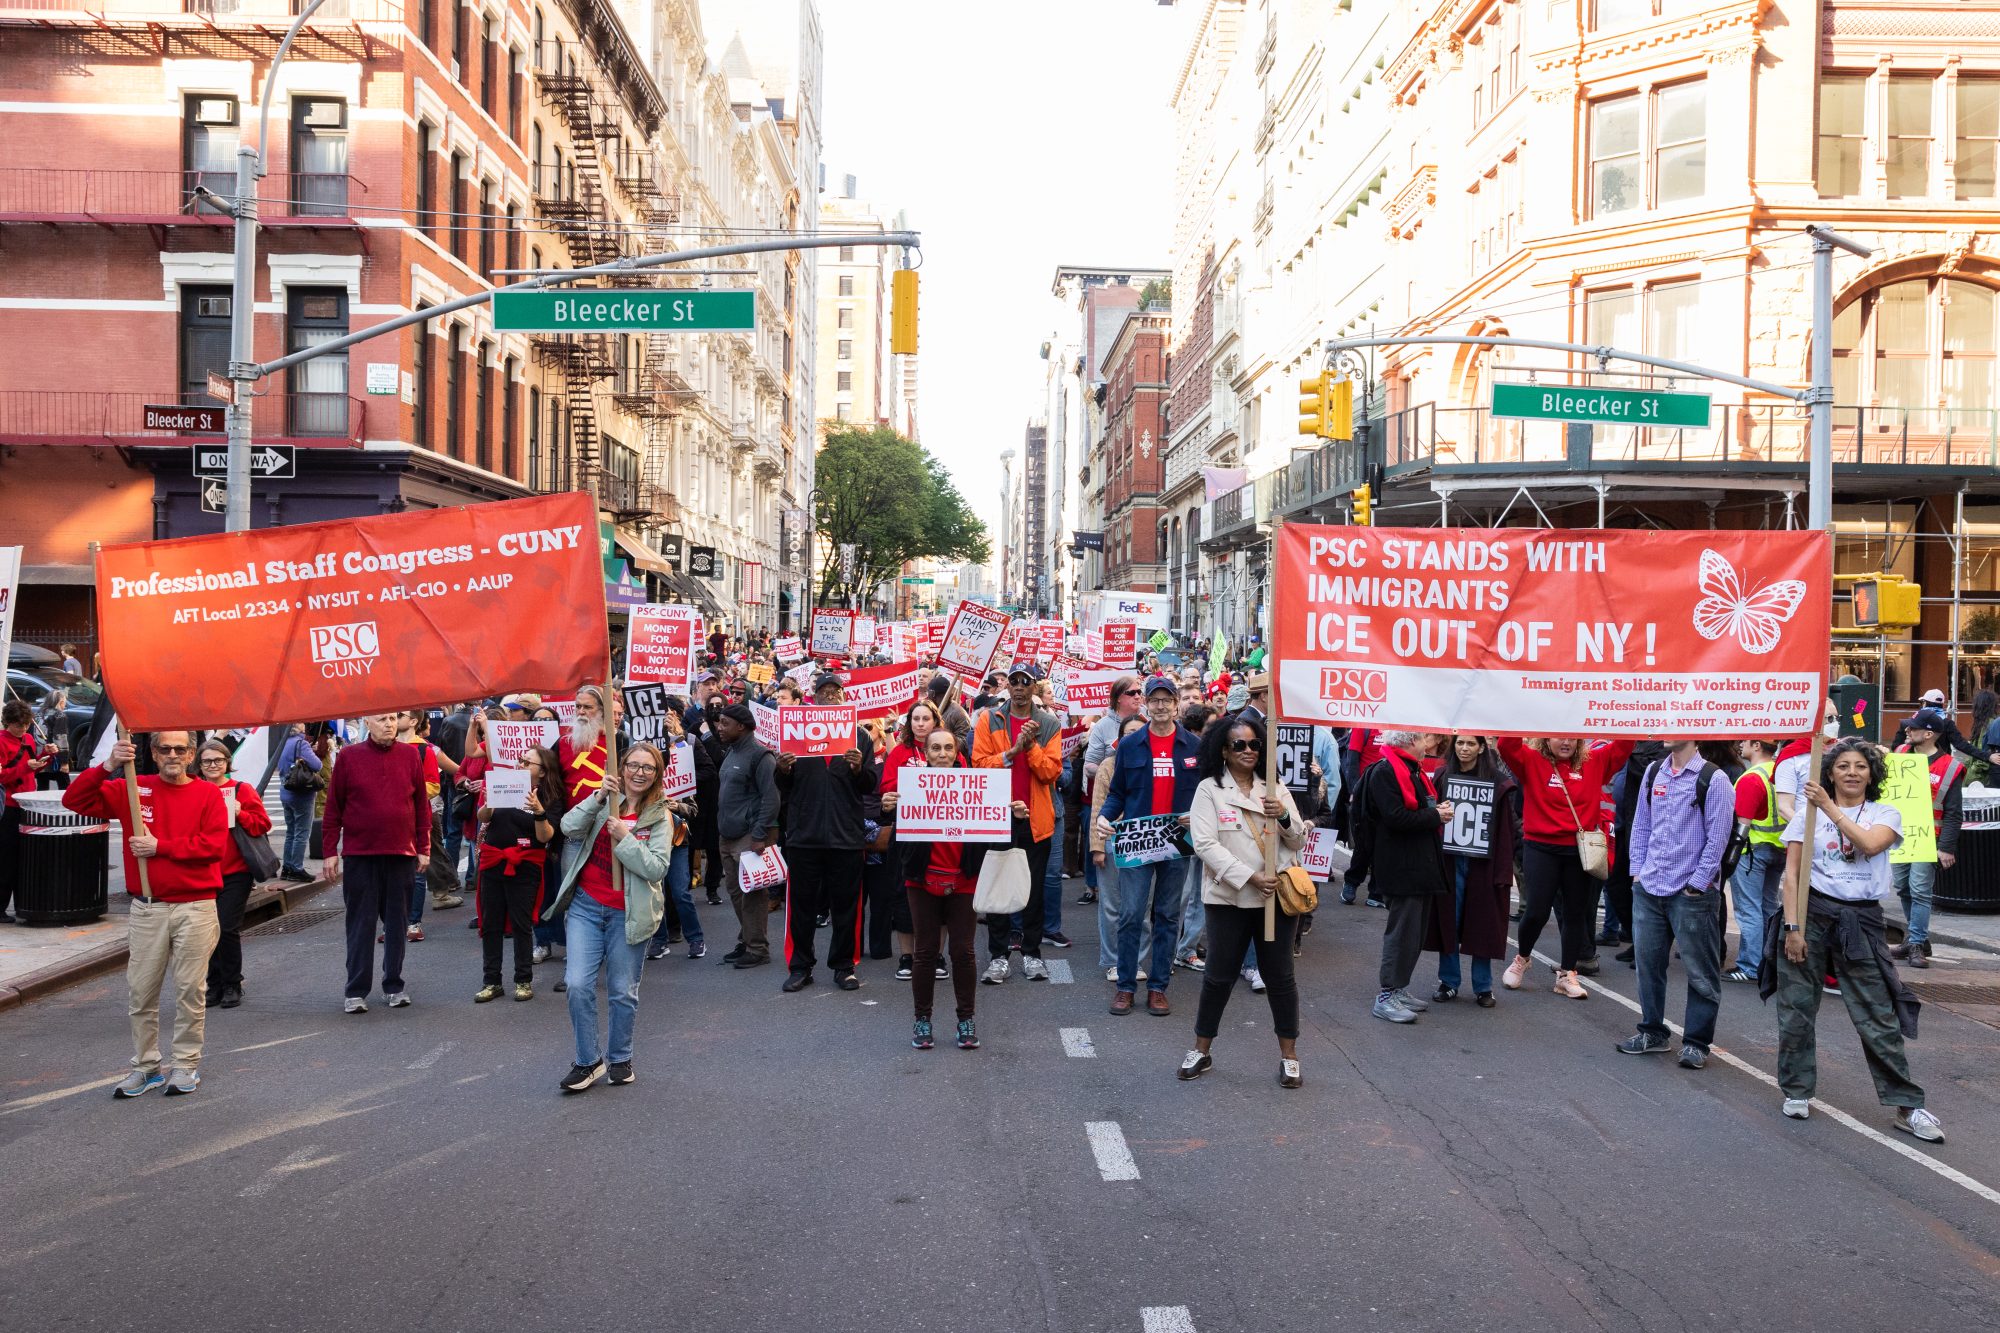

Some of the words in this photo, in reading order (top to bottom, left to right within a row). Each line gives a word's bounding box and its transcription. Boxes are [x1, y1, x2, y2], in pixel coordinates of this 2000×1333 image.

[554, 299, 661, 321] Bleecker
[672, 300, 695, 321] St
[209, 376, 231, 402] Broadway
[1542, 393, 1631, 416] Bleecker
[1640, 398, 1659, 418] St
[147, 411, 195, 429] Bleecker
[200, 413, 212, 430] St
[209, 454, 228, 467] ON
[251, 455, 278, 467] WAY
[209, 489, 223, 503] ONE
[111, 562, 259, 599] Professional
[265, 552, 337, 585] Staff
[343, 544, 473, 574] Congress
[498, 525, 582, 557] CUNY
[1309, 536, 1368, 568] PSC
[1381, 539, 1509, 572] STANDS
[1526, 541, 1606, 573] WITH
[172, 607, 199, 625] AFT
[203, 604, 241, 622] Local
[244, 599, 290, 618] 2334
[307, 590, 360, 611] NYSUT
[379, 581, 448, 603] AFL-CIO
[466, 573, 514, 592] AAUP
[1308, 573, 1510, 612] IMMIGRANTS
[637, 606, 688, 618] PSC-CUNY
[816, 608, 850, 616] PSC-CUNY
[965, 603, 1006, 622] PSC-CUNY
[1119, 601, 1153, 614] FedEx
[643, 623, 679, 634] MONEY
[815, 616, 848, 625] CUNY
[960, 613, 998, 633] HANDS
[312, 623, 378, 661] PSC
[650, 634, 670, 644] FOR
[949, 634, 982, 651] NEW
[960, 628, 987, 641] OFF
[1306, 611, 1371, 654] ICE
[1391, 616, 1476, 660] OUT
[1497, 620, 1554, 662] OF
[1576, 622, 1633, 663] NY
[632, 644, 687, 656] EDUCATION
[955, 649, 983, 666] YORK
[648, 655, 670, 665] NOT
[321, 659, 374, 679] CUNY
[631, 665, 686, 677] OLIGARCHS
[845, 688, 861, 702] AX
[862, 683, 888, 699] THE
[891, 674, 917, 694] RICH
[1068, 687, 1089, 699] TAX
[1088, 685, 1110, 697] THE
[1321, 668, 1388, 702] PSC
[1521, 677, 1608, 693] Immigrant
[1612, 678, 1688, 695] Solidarity
[1692, 678, 1761, 694] Working
[1765, 679, 1811, 694] Group
[625, 688, 666, 717] ICE
[867, 694, 902, 707] AFFORDABLE
[1587, 700, 1667, 712] Professional
[1670, 700, 1702, 711] Staff
[1705, 701, 1765, 714] Congress
[1775, 700, 1809, 711] CUNY
[756, 707, 772, 720] STOP
[783, 710, 804, 722] FAIR
[805, 709, 853, 722] CONTRACT
[1326, 702, 1380, 718] CUNY
[632, 715, 665, 740] OUT
[759, 718, 774, 731] WAR
[1584, 718, 1608, 727] AFT
[1611, 717, 1641, 727] Local
[1643, 718, 1667, 728] 2334
[1676, 718, 1717, 727] NYSUT
[1725, 718, 1771, 727] AFL-CIO
[1779, 717, 1808, 727] AAUP
[497, 725, 520, 737] STOP
[522, 725, 545, 737] THE
[783, 721, 854, 741] NOW
[1276, 728, 1310, 743] OLISH
[500, 737, 522, 749] WAR
[525, 737, 541, 748] ON
[1277, 743, 1310, 786] CE
[1887, 758, 1920, 780] AR
[662, 772, 692, 789] ANTS!
[918, 773, 956, 789] STOP
[960, 774, 988, 789] THE
[925, 789, 959, 805] WAR
[963, 790, 983, 805] ON
[1446, 784, 1494, 803] ABOLISH
[900, 805, 1007, 822] UNIVERSITIES!
[945, 827, 962, 836] PSC
[1111, 820, 1138, 834] WE
[1443, 801, 1492, 848] ICE
[1115, 829, 1157, 843] FOR
[1308, 832, 1321, 843] HE
[1115, 837, 1165, 855] WORKERS
[1303, 854, 1329, 868] TIES!
